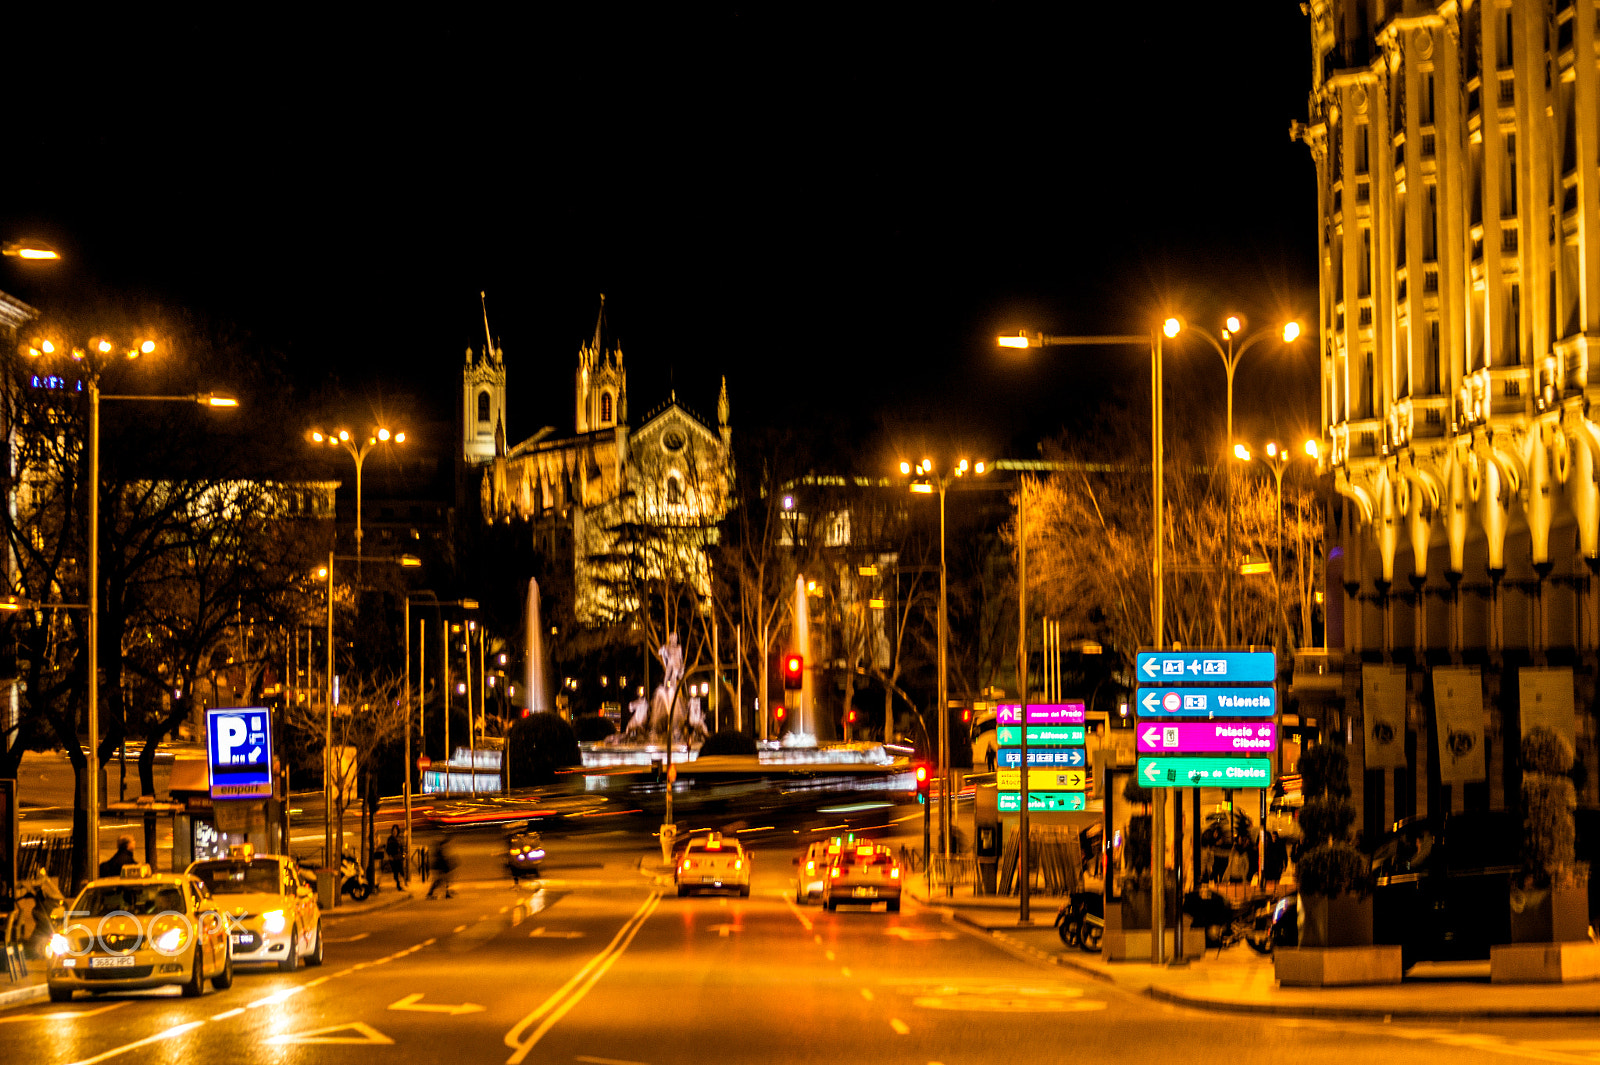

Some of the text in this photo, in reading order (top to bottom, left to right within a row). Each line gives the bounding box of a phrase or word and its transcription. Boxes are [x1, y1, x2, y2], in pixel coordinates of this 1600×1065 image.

[1165, 661, 1182, 672] A-1
[1218, 695, 1270, 707] Valencia
[1061, 709, 1083, 718] Prado
[1215, 726, 1271, 737] Palacio de
[1232, 737, 1271, 748] Cibeles
[1212, 769, 1223, 778] de
[1226, 766, 1266, 778] Cibeles
